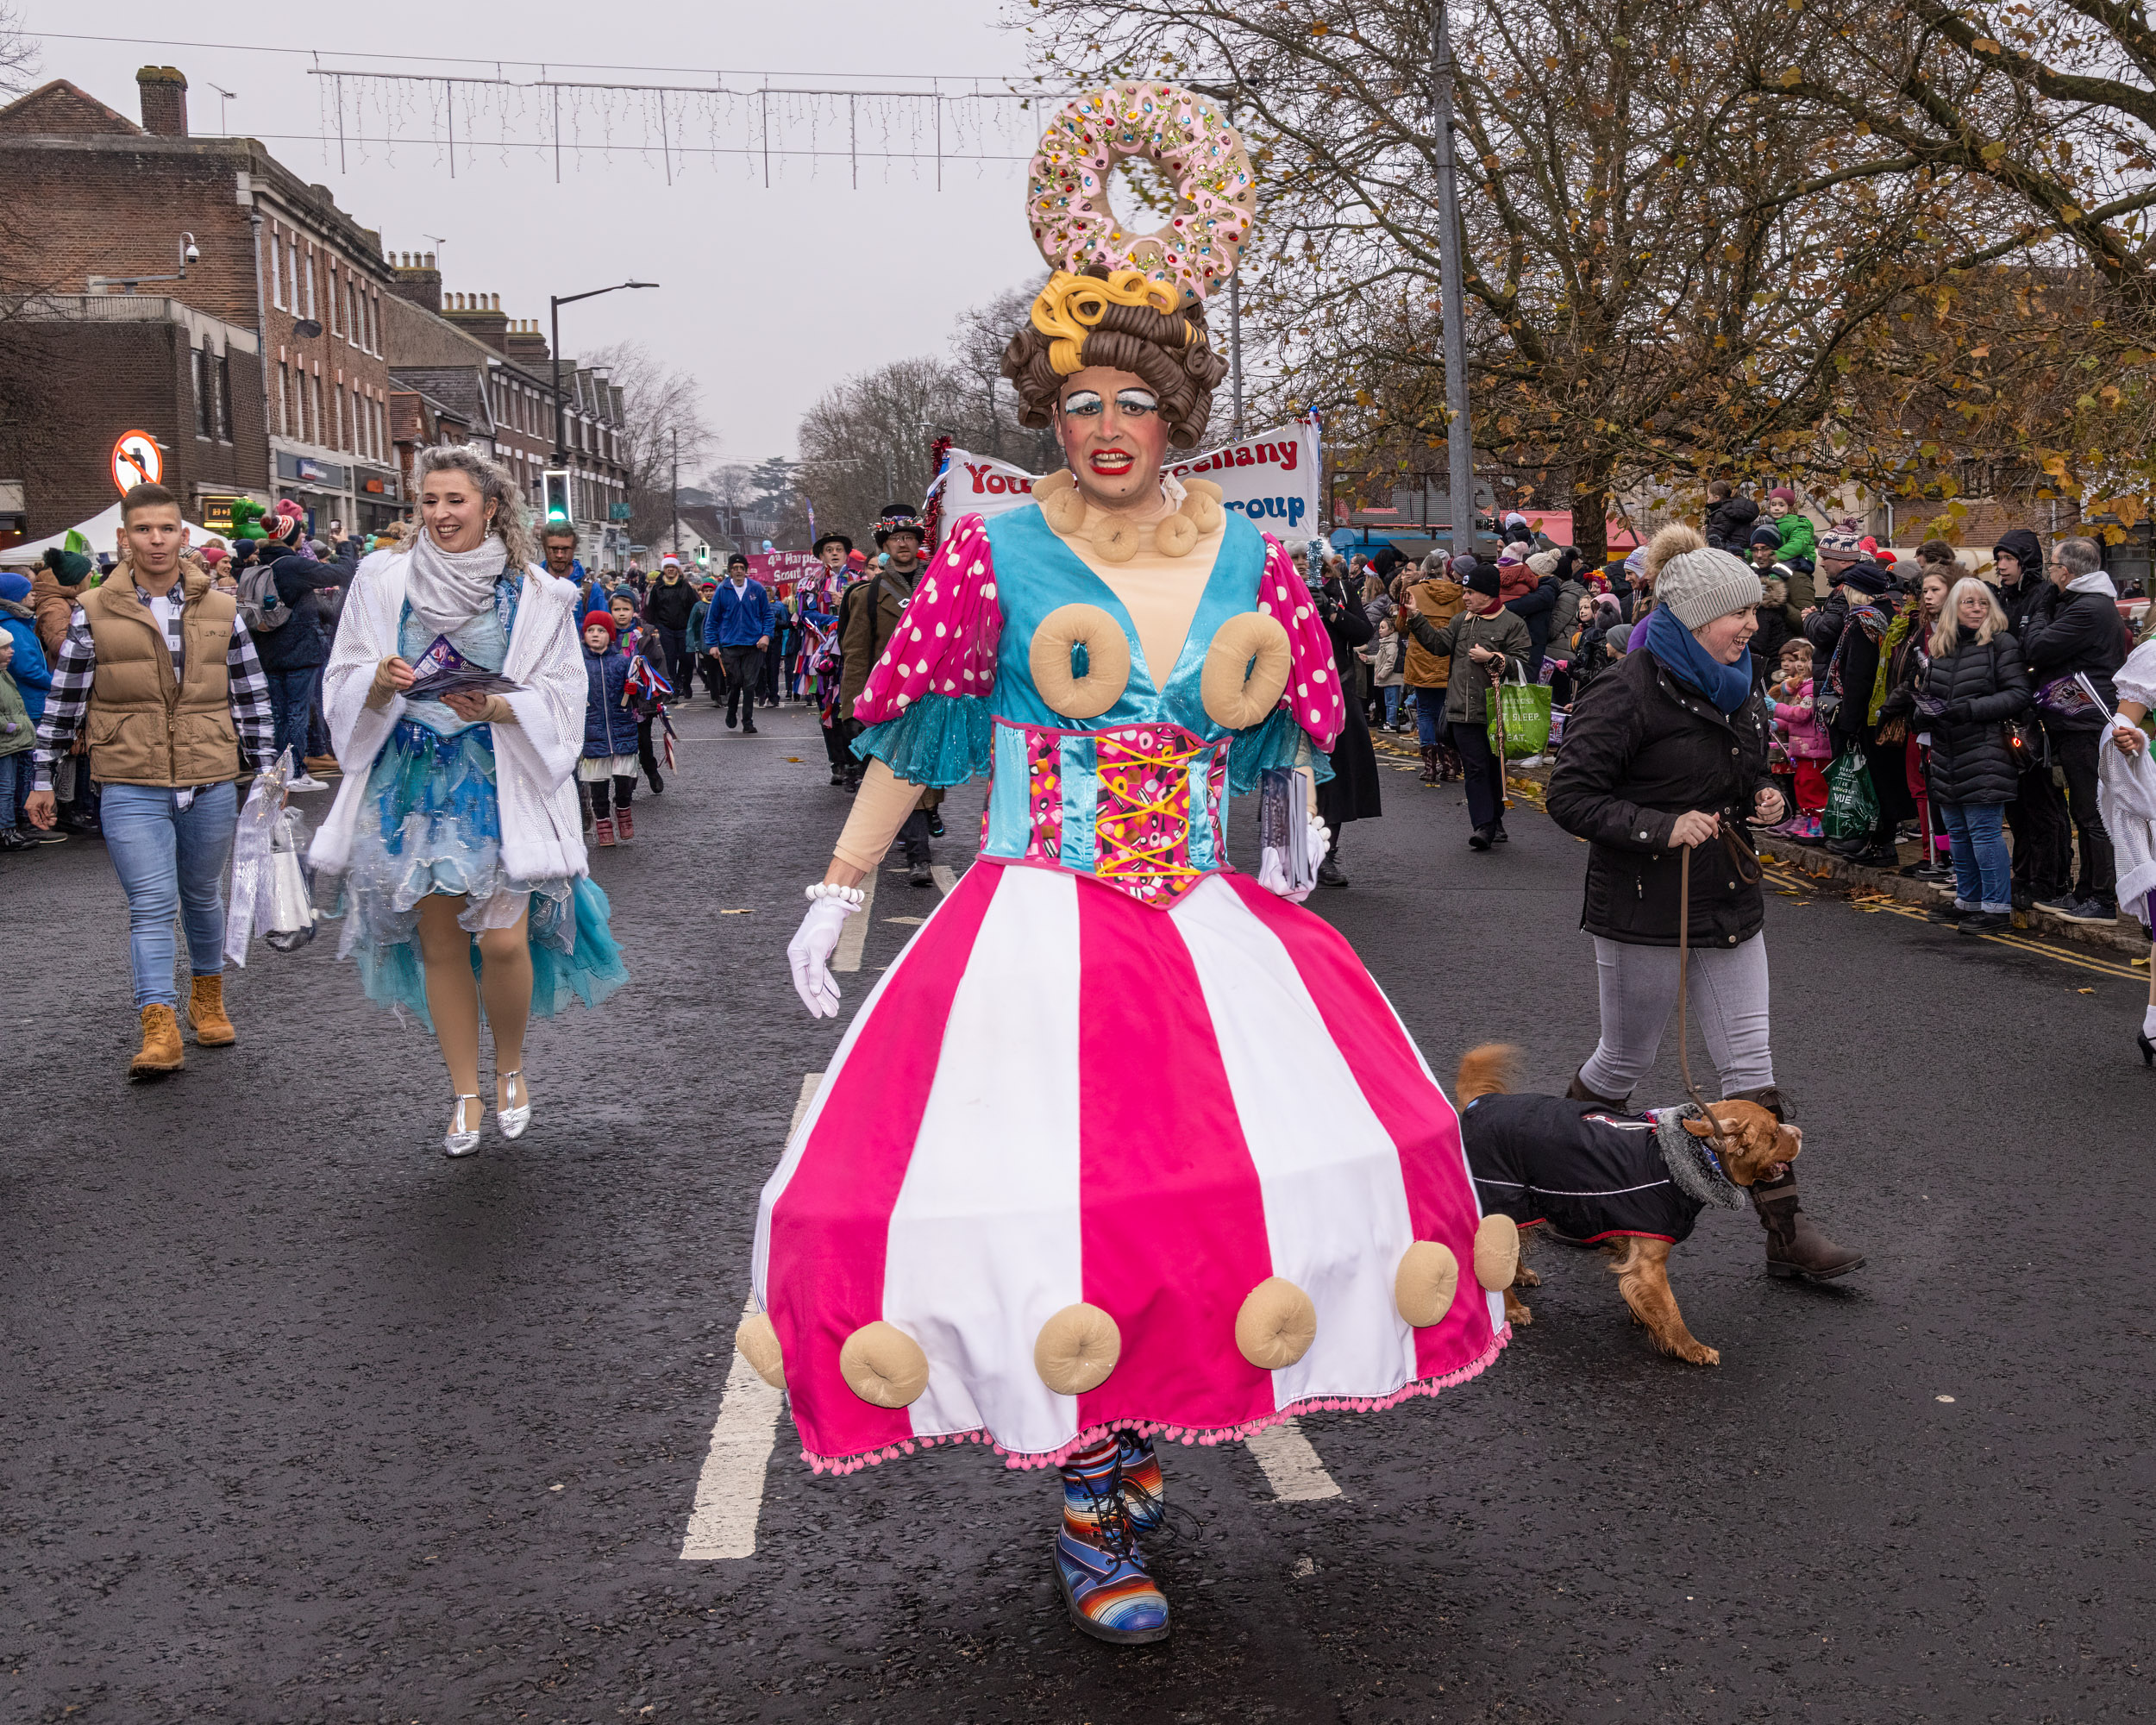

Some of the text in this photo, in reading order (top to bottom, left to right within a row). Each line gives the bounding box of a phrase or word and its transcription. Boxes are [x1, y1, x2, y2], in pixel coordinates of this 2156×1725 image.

[966, 463, 1033, 494] You
[1224, 496, 1305, 527] roup
[774, 568, 802, 582] Scout
